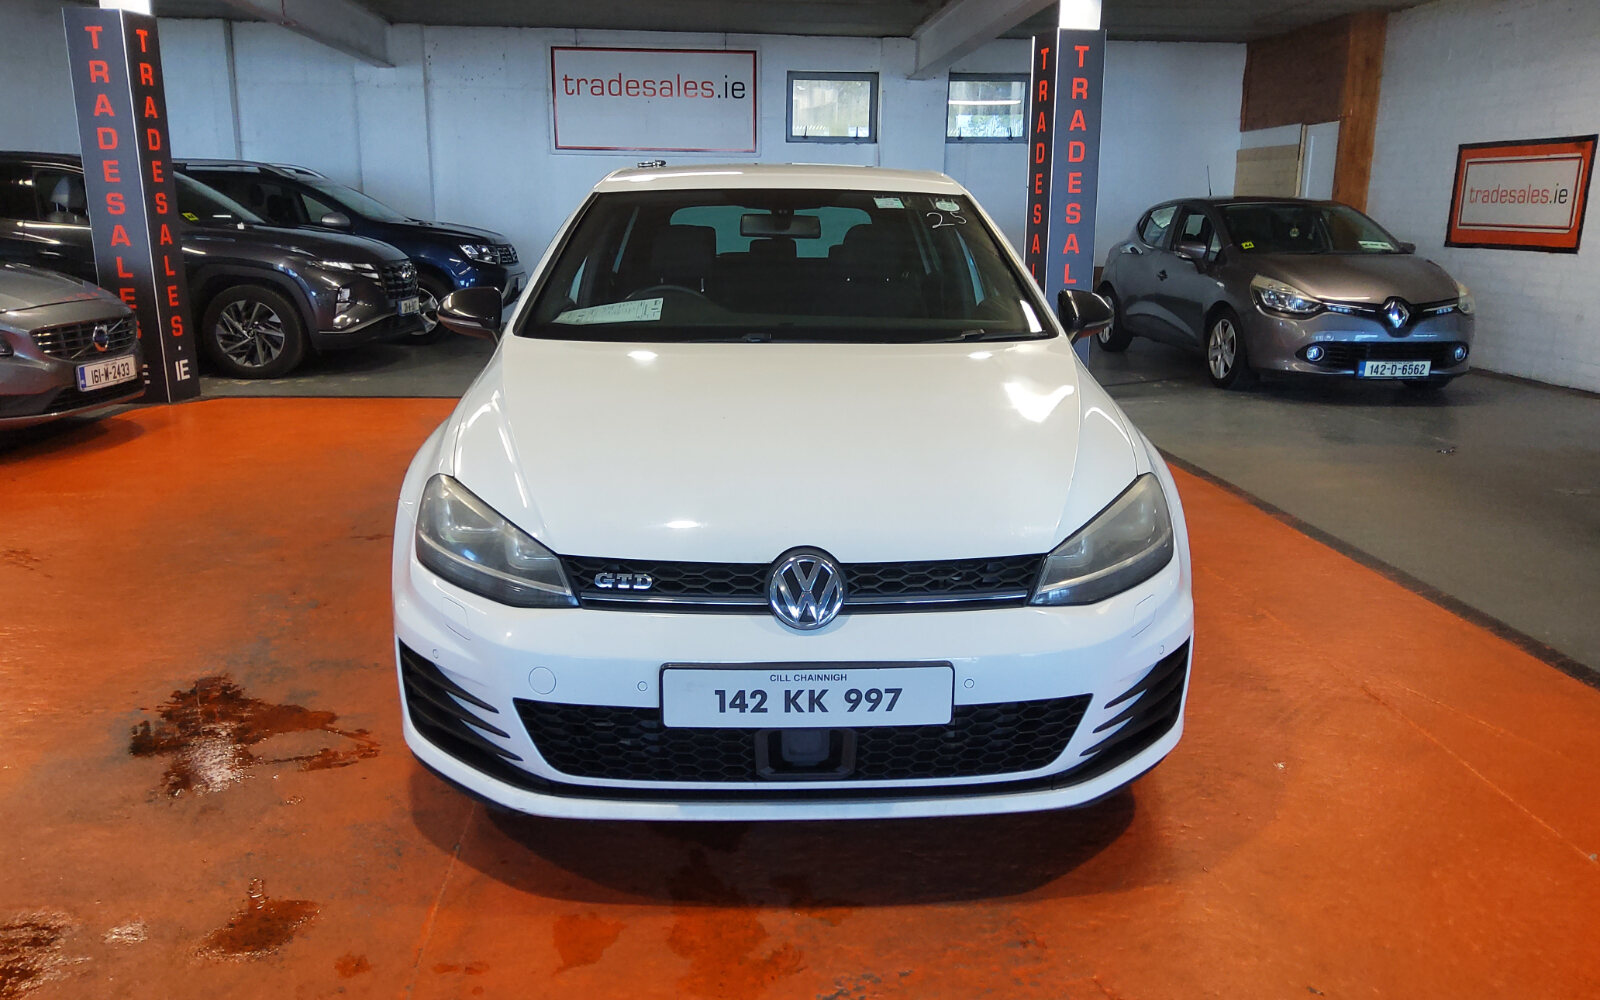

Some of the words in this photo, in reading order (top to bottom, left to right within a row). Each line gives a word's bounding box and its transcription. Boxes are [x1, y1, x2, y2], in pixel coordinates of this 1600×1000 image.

[562, 73, 746, 99] tradesales.ie
[1469, 183, 1568, 205] tradesales.ie
[91, 362, 130, 385] 161-W-2433
[1370, 364, 1426, 376] 142-D-6562
[594, 572, 653, 590] GTD
[769, 673, 791, 682] CILL
[793, 673, 848, 682] CHAINNIGH
[714, 689, 769, 713] 142
[784, 689, 830, 713] KK
[843, 688, 903, 713] 997
